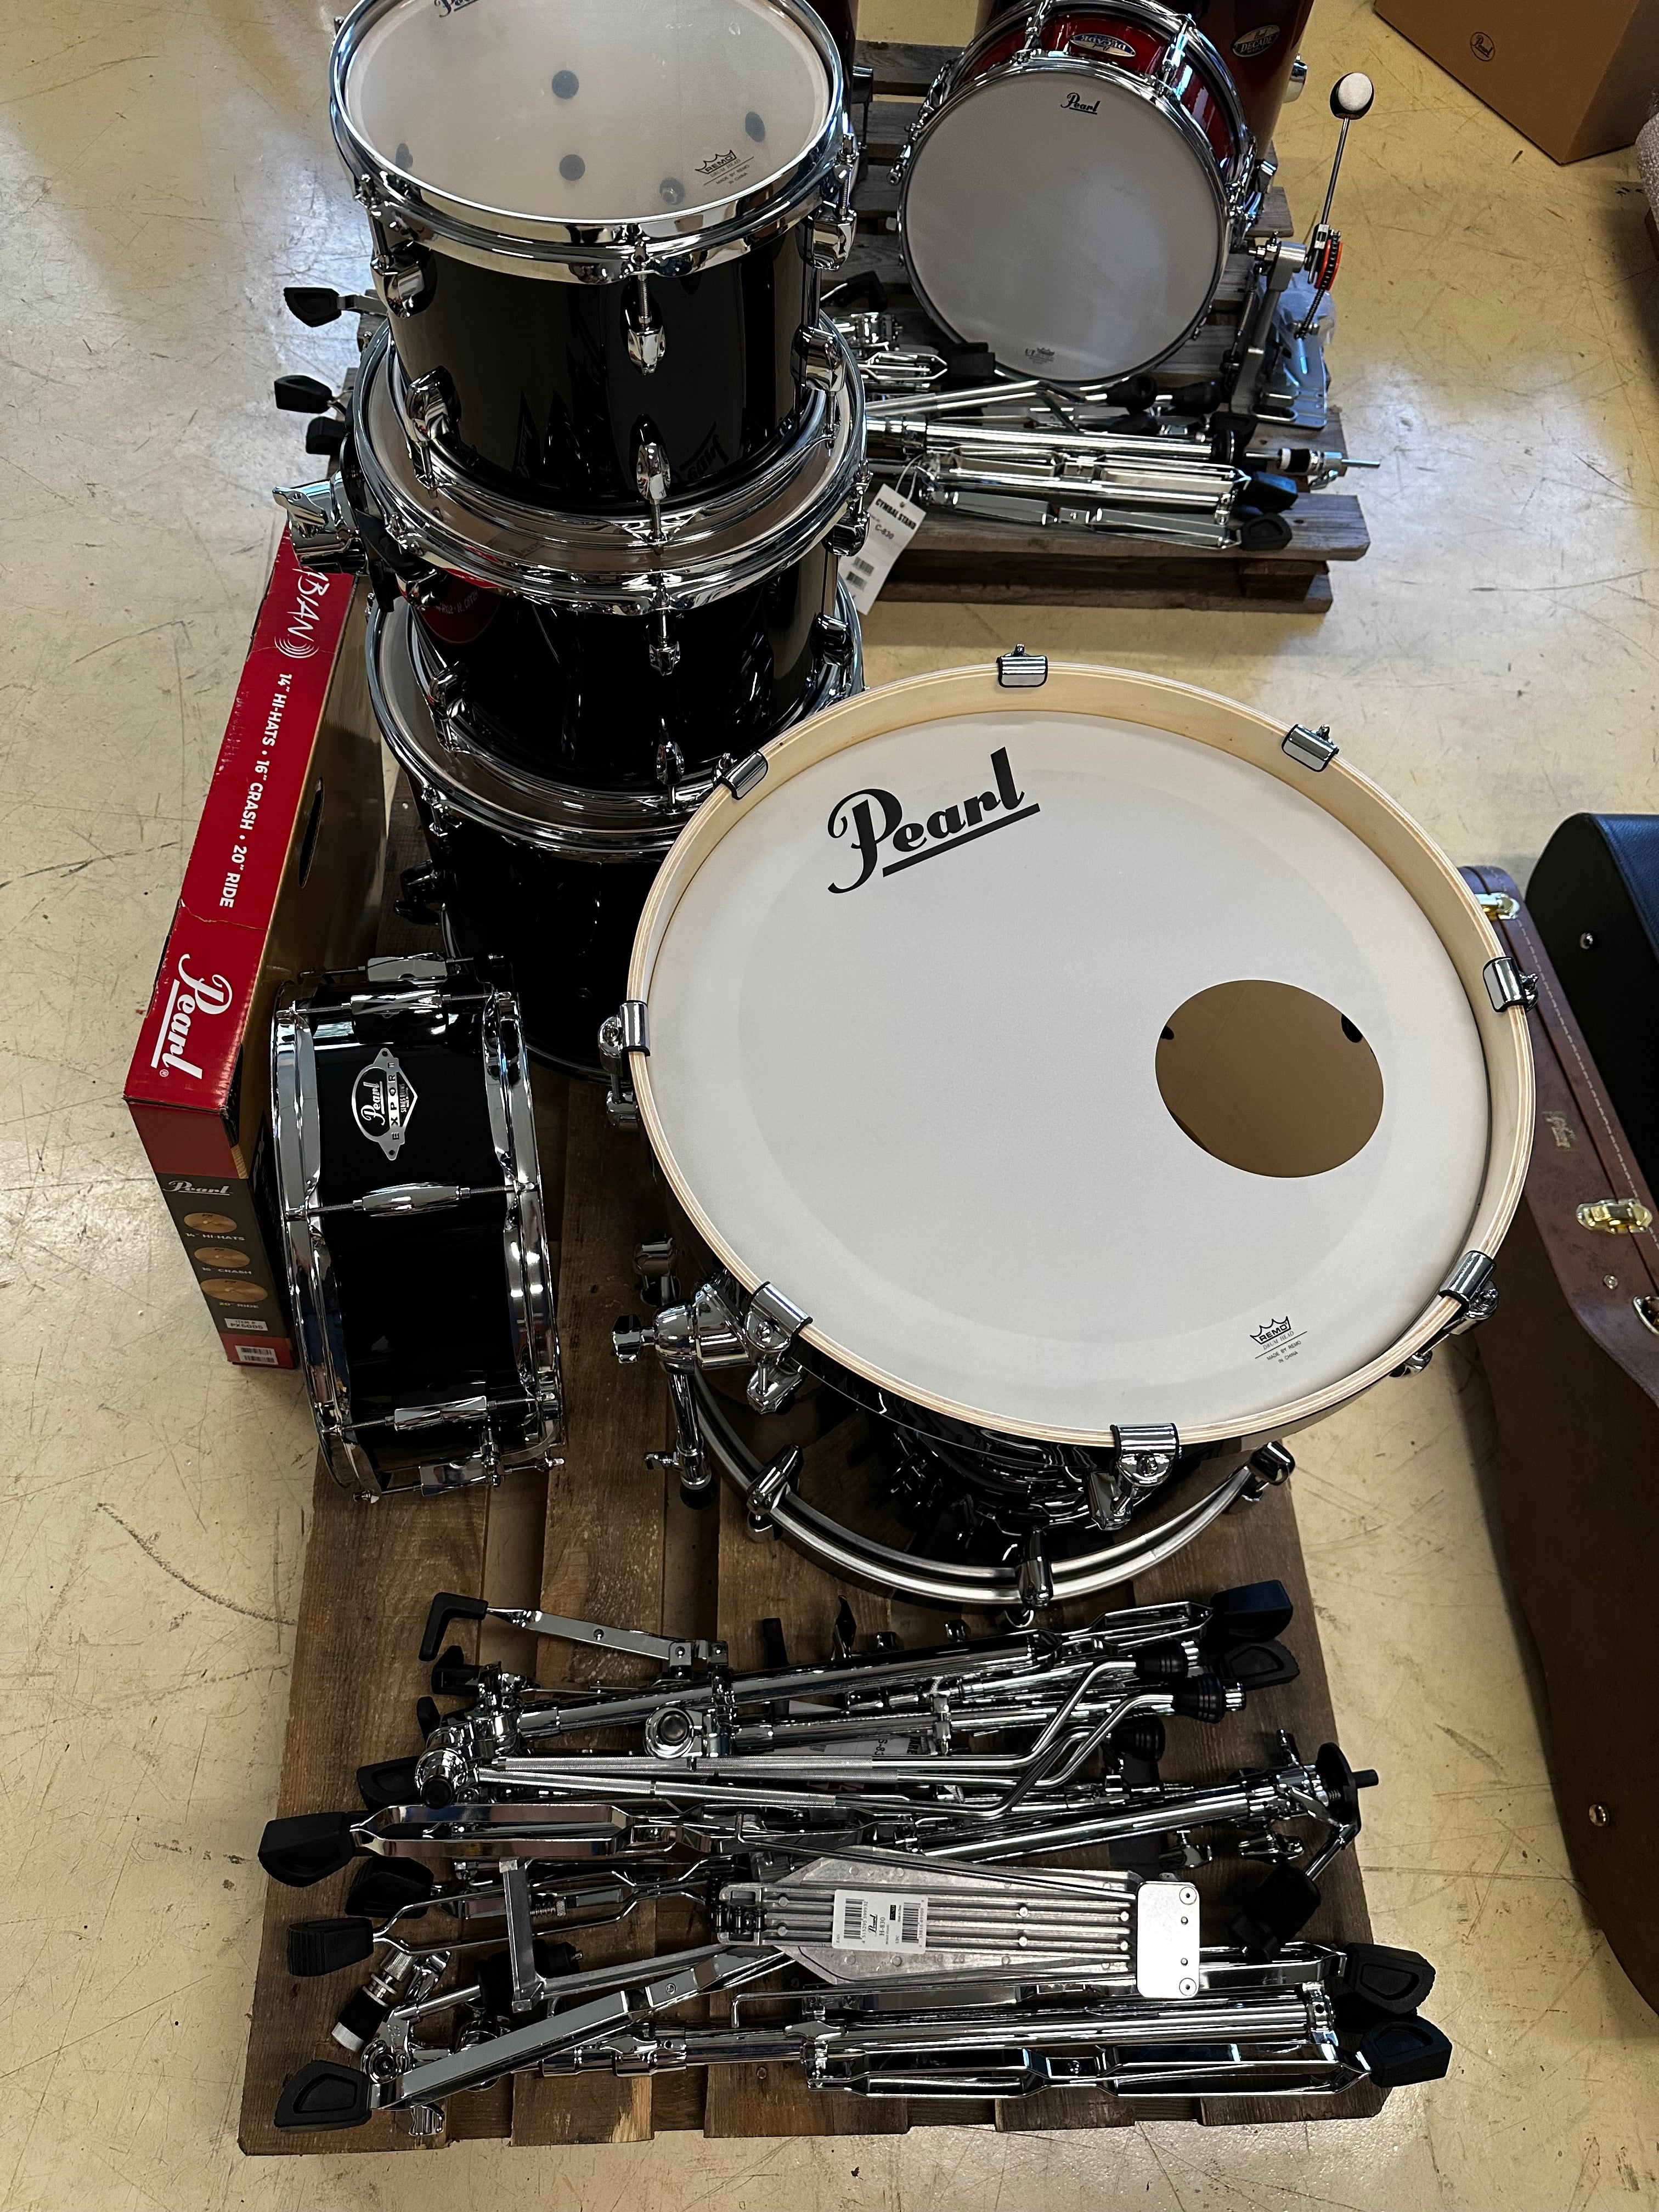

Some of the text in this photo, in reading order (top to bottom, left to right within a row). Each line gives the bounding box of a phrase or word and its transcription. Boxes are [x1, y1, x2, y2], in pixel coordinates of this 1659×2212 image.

[1060, 92, 1101, 115] Pearl
[705, 155, 733, 172] REMO
[874, 523, 895, 540] C-830
[897, 513, 917, 530] STAND
[219, 673, 292, 908] 14" HI-HATS 16" CRASH 20" RIDE
[827, 746, 1040, 894] Pearl
[151, 953, 233, 1080] Pearl
[360, 1081, 385, 1126] Pearl
[387, 1062, 400, 1141] EXPORT
[162, 1180, 230, 1196] Pearl
[1259, 1323, 1288, 1342] REMO
[1262, 1330, 1294, 1350] DRUM HEAD
[1266, 1351, 1280, 1361] MADE
[1288, 1340, 1302, 1350] REMO
[1284, 1350, 1299, 1360] CHINA
[867, 1914, 878, 1937] Pearl
